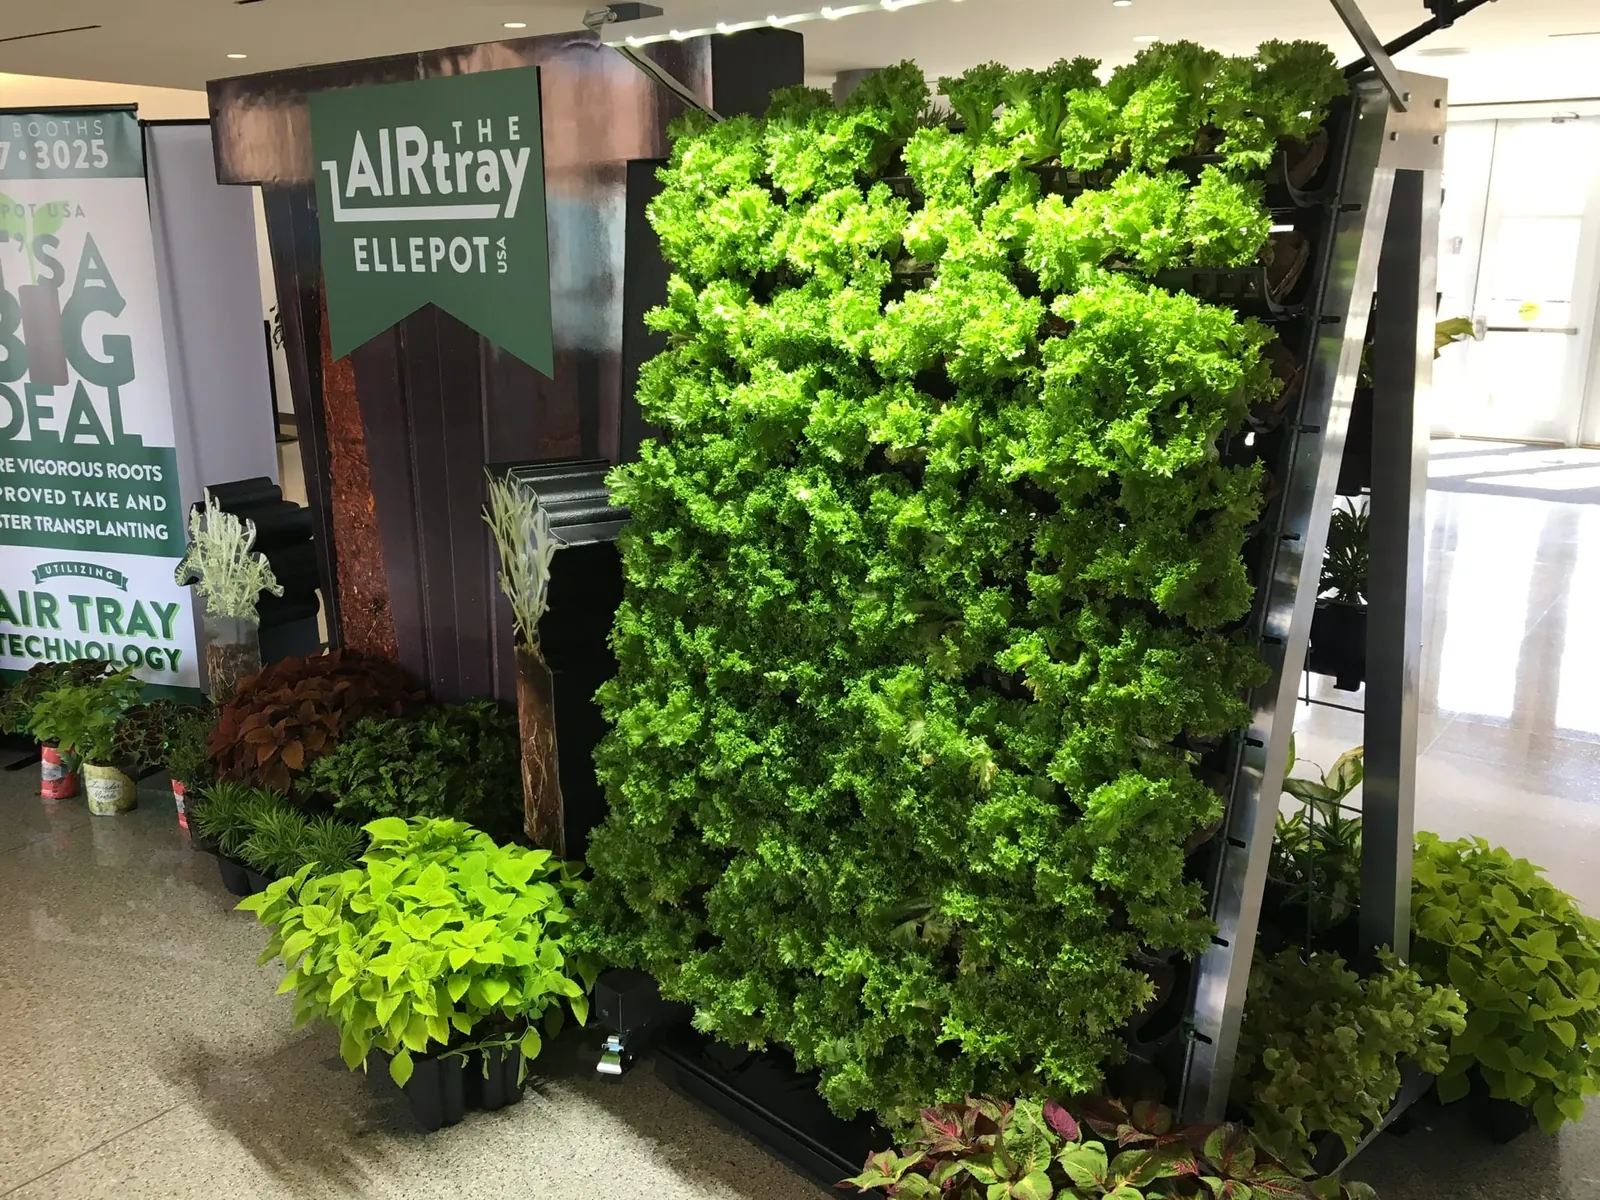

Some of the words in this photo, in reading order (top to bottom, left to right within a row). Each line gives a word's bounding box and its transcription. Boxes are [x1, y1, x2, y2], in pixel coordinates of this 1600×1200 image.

[13, 119, 104, 138] BOOTHS
[452, 115, 520, 144] THE
[33, 139, 109, 170] 3025
[345, 125, 531, 218] AIRtray
[47, 203, 85, 219] USA
[353, 236, 489, 274] ELLEPOT
[496, 236, 508, 274] USA
[16, 458, 104, 478] VIGOROUS
[107, 463, 163, 482] ROOTS
[72, 490, 120, 509] TAKE
[126, 494, 167, 512] AND
[34, 516, 169, 541] TRANSPLANTING
[44, 563, 114, 581] UTILIZING
[68, 594, 181, 641] TRAY
